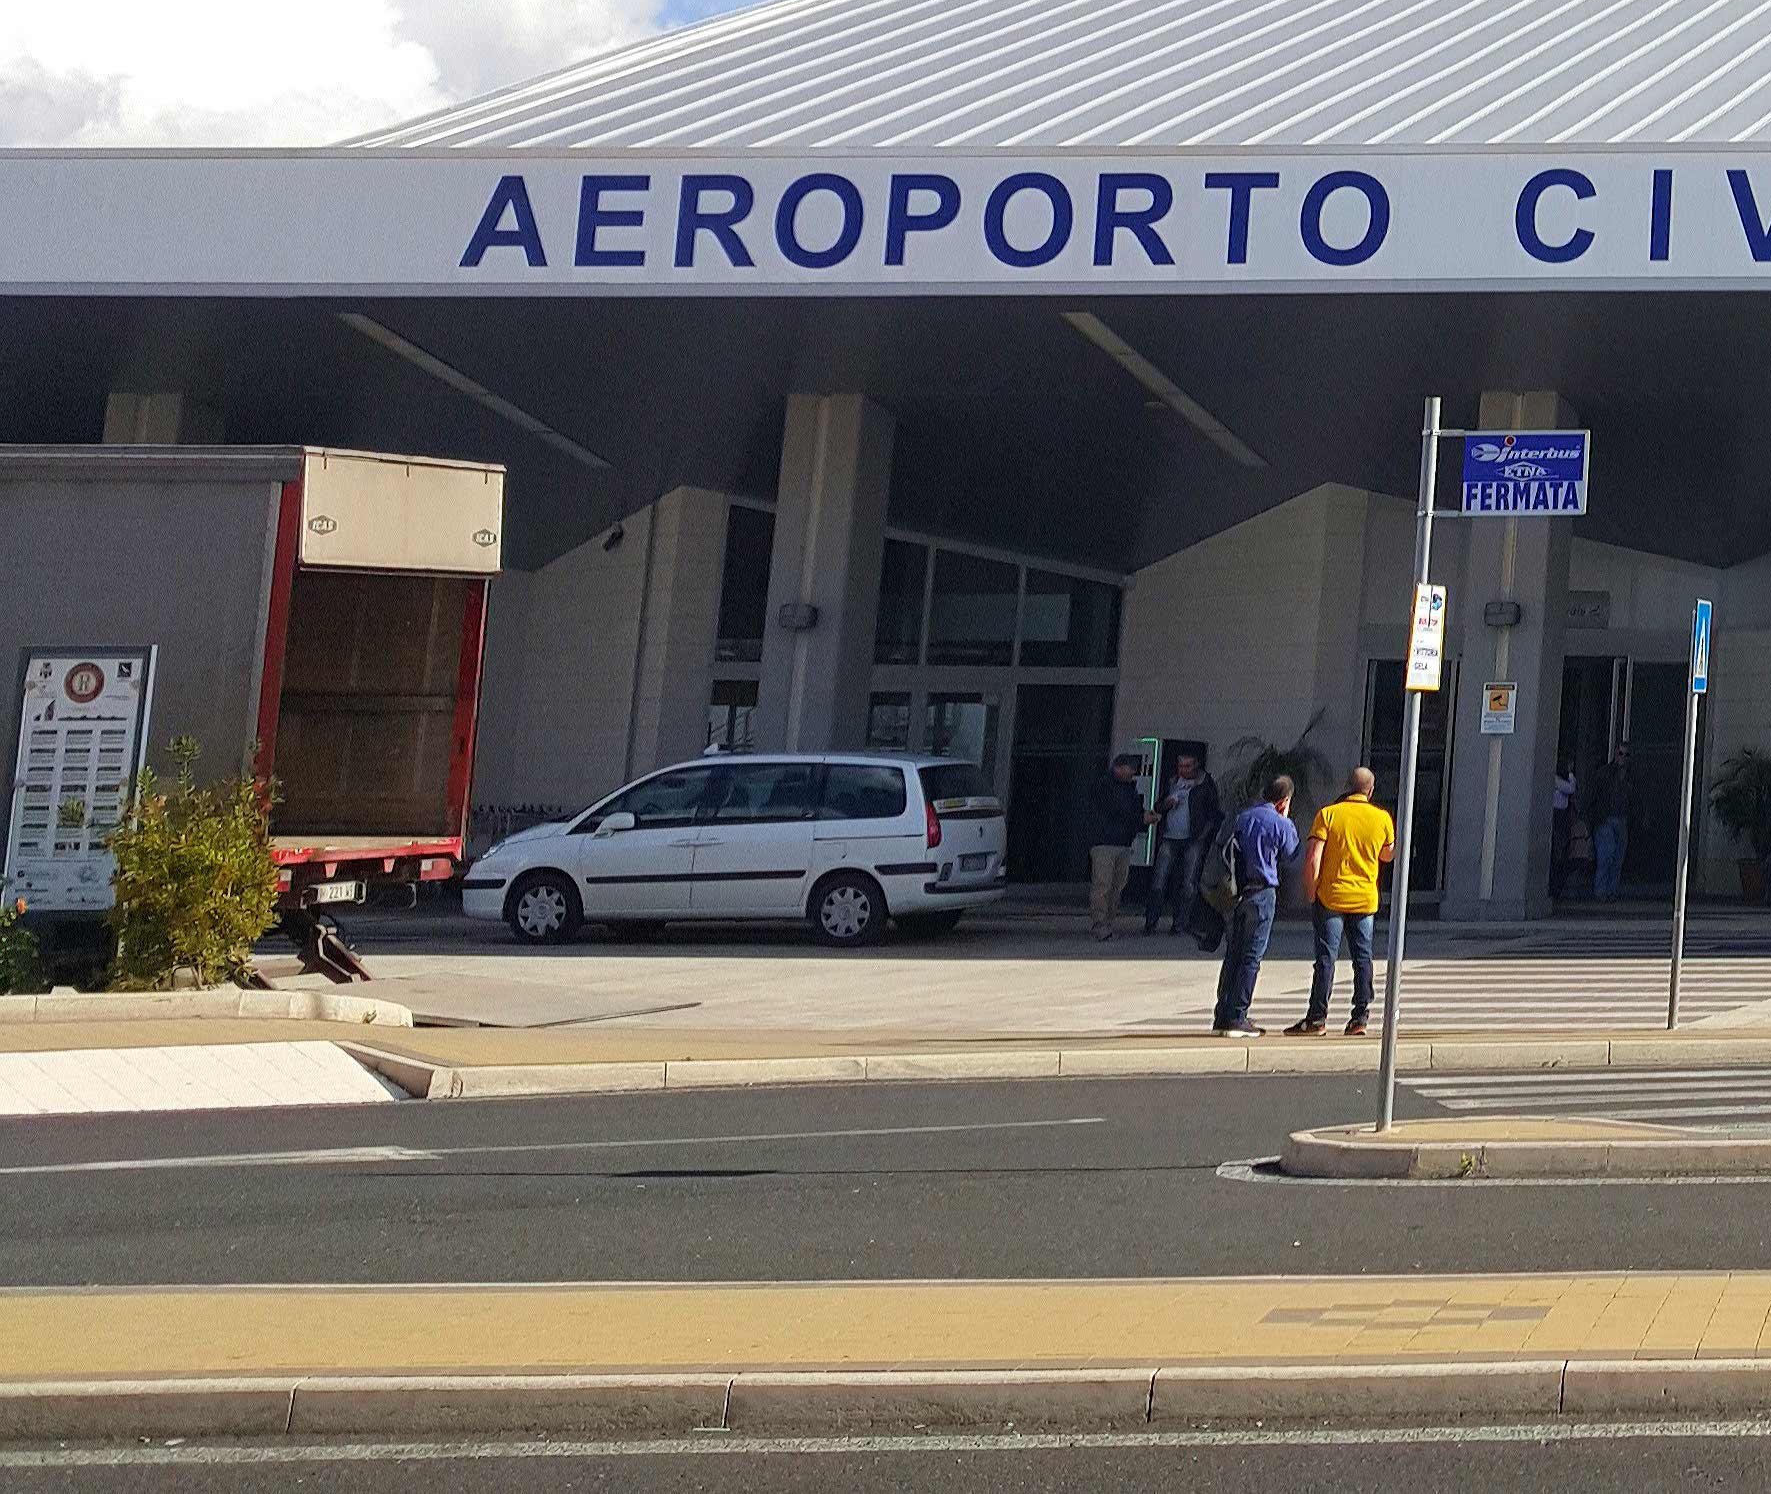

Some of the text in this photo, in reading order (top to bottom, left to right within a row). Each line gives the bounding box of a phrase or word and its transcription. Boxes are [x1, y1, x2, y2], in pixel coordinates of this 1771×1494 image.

[461, 172, 1390, 268] AEROPORTO
[1504, 465, 1547, 477] ETNA
[1465, 481, 1580, 511] FERMATA
